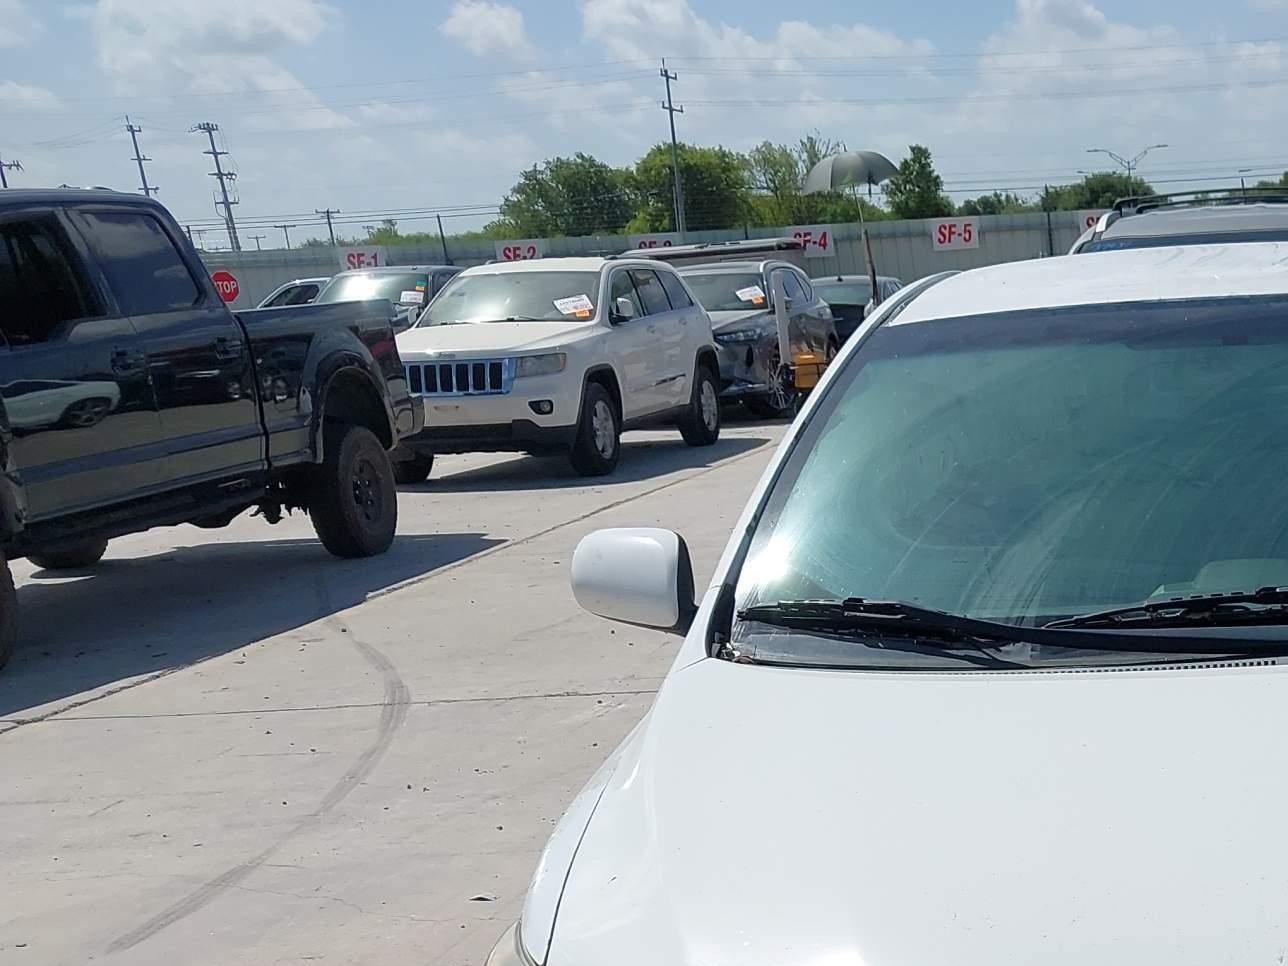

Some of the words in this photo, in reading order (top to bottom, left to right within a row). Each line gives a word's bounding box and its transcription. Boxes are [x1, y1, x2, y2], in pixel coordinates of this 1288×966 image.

[937, 223, 972, 244] SF-5
[346, 252, 379, 269] SF-1
[214, 280, 238, 293] TOP
